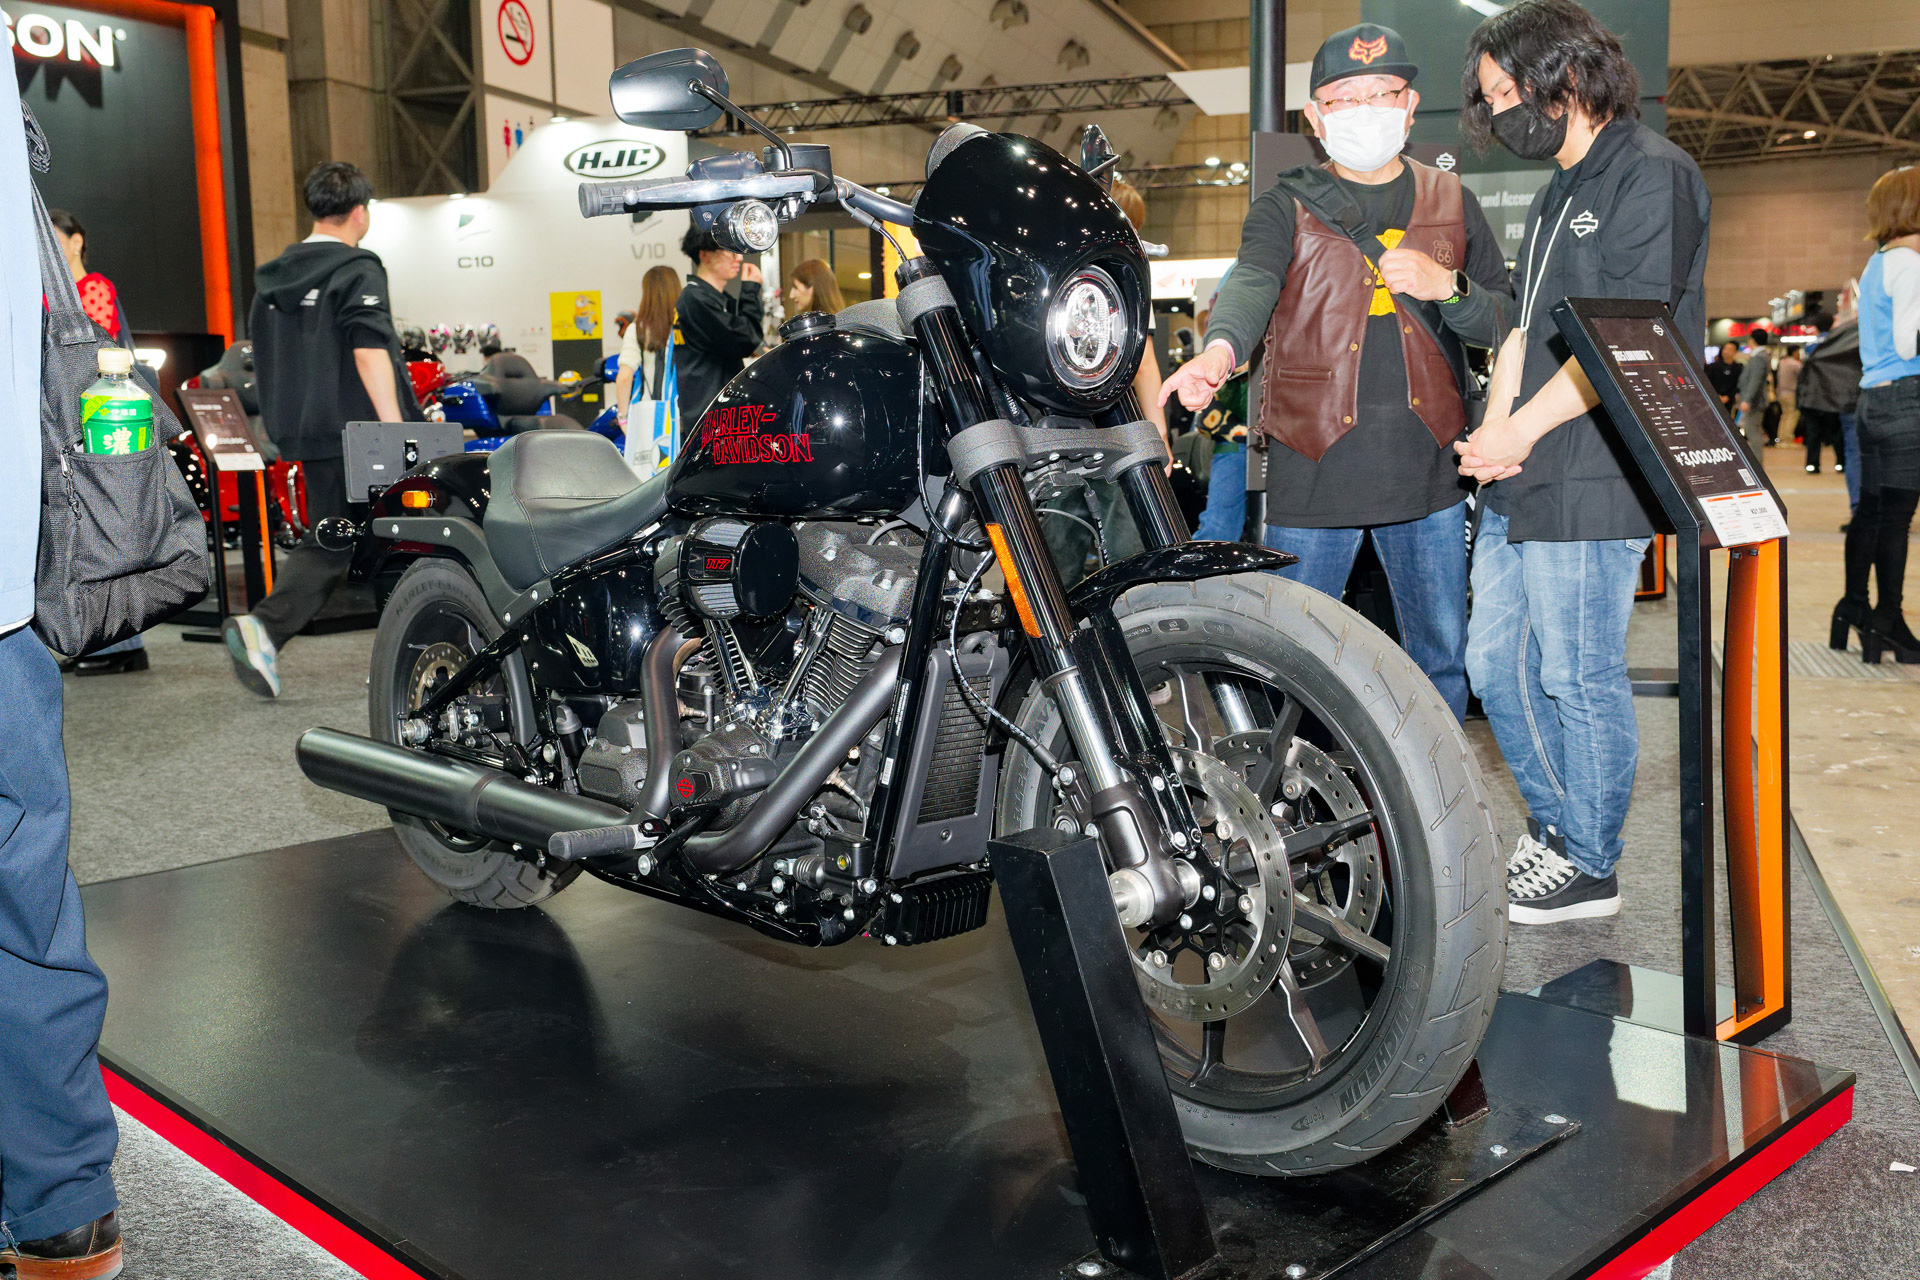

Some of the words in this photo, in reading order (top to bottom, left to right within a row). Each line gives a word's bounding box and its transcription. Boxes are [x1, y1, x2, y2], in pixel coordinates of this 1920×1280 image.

[577, 148, 651, 170] HJC
[630, 243, 666, 260] V10
[1437, 249, 1451, 263] 66
[458, 255, 494, 268] C10
[701, 404, 777, 450] HARLEY-
[713, 433, 813, 465] DAVIDSON
[705, 558, 731, 570] 117
